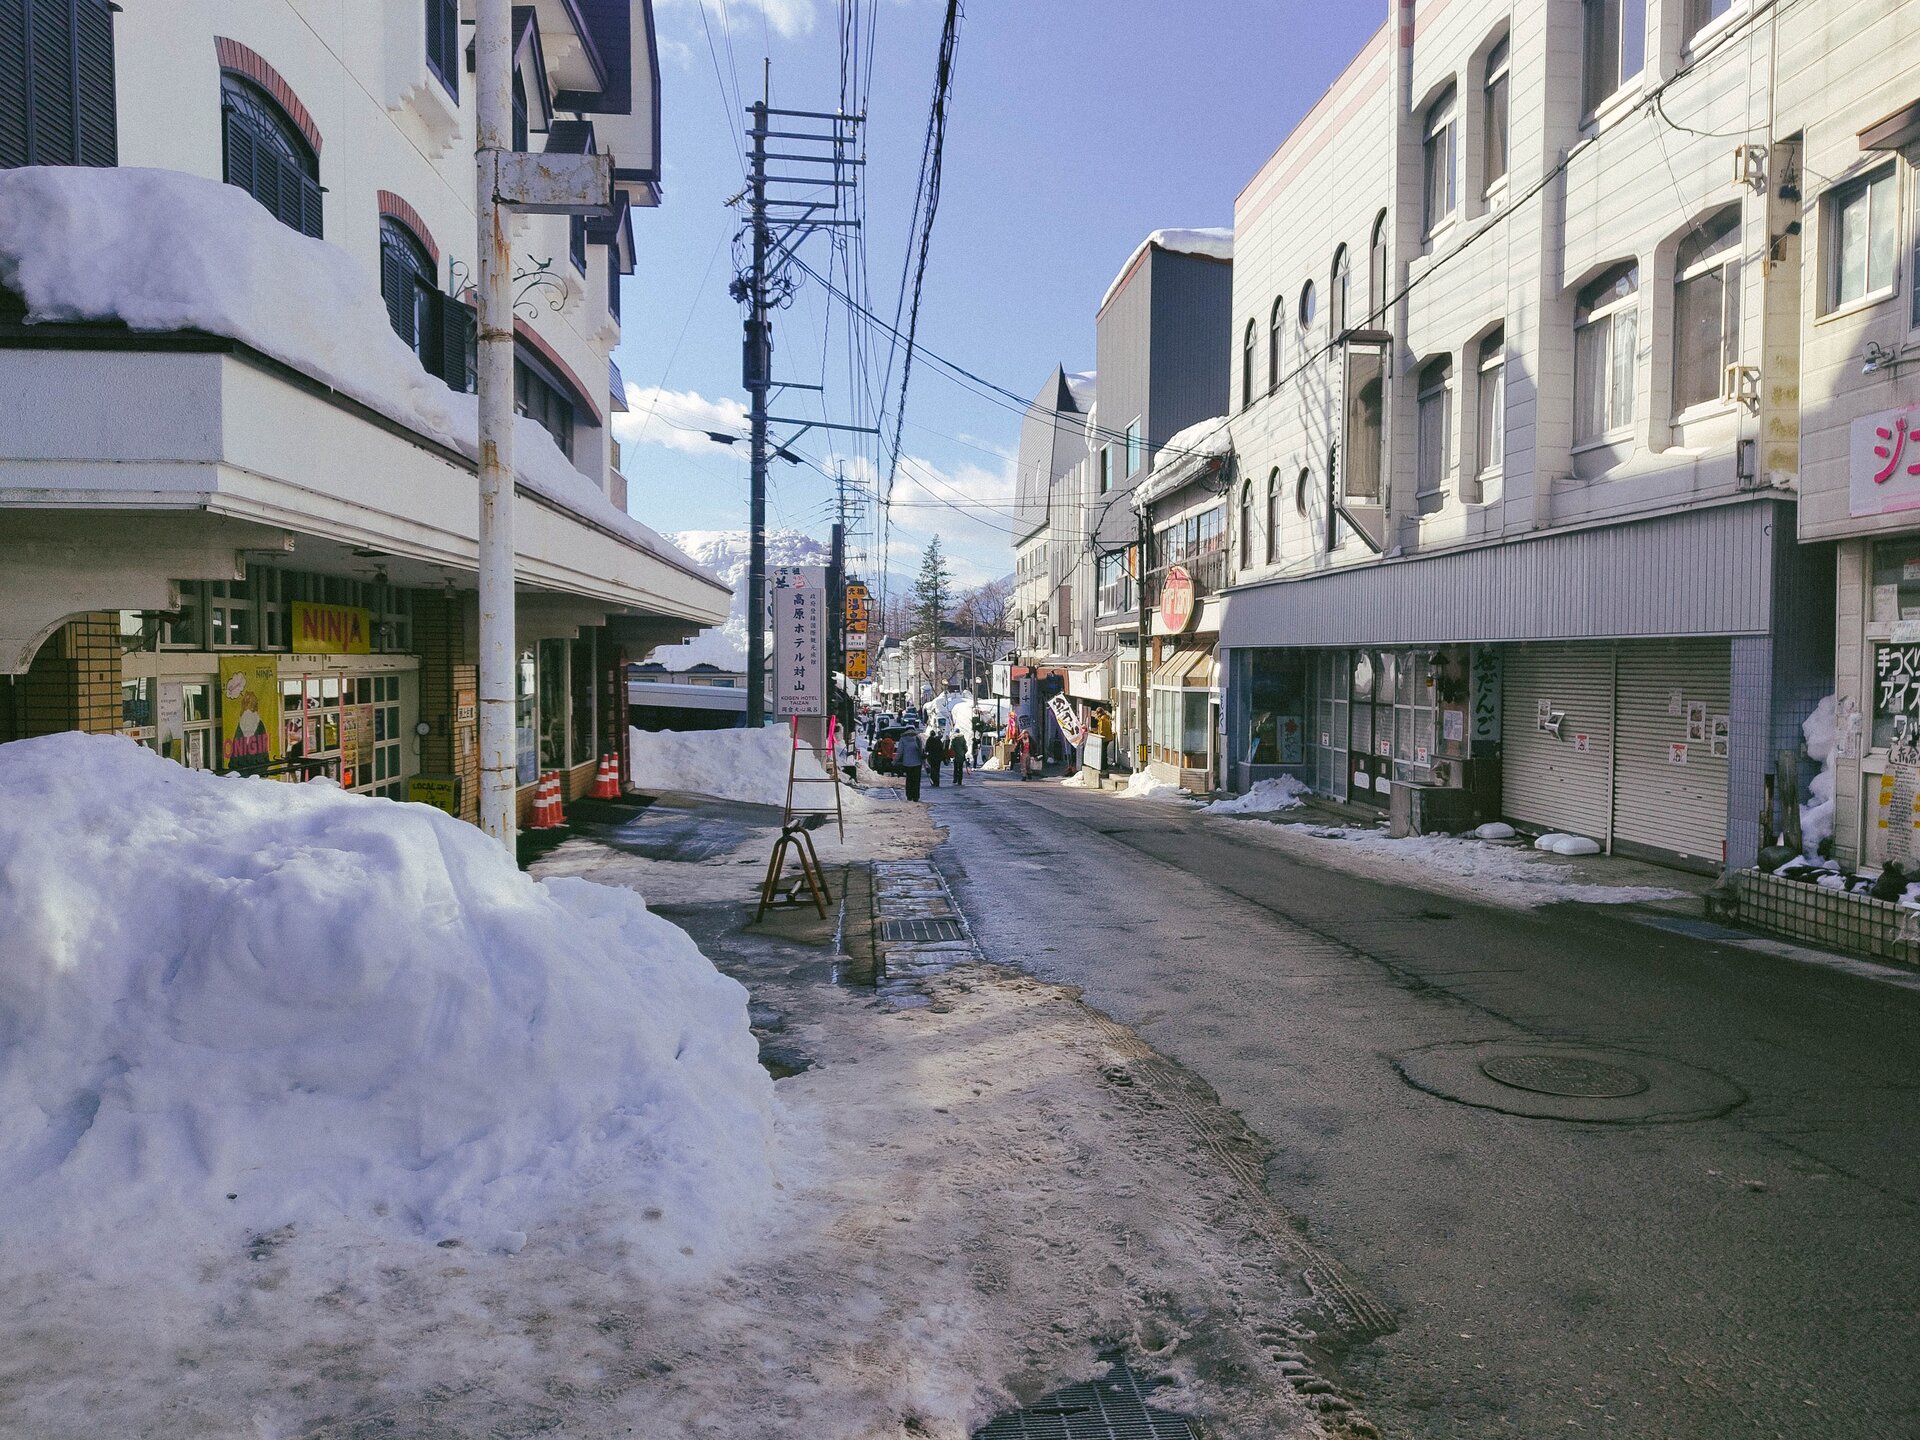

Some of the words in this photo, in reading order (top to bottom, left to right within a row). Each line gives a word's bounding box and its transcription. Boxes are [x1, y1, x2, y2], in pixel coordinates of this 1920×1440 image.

[302, 608, 363, 651] NINJA
[793, 593, 805, 691] 高原ホテル対山
[255, 669, 273, 680] NINJA
